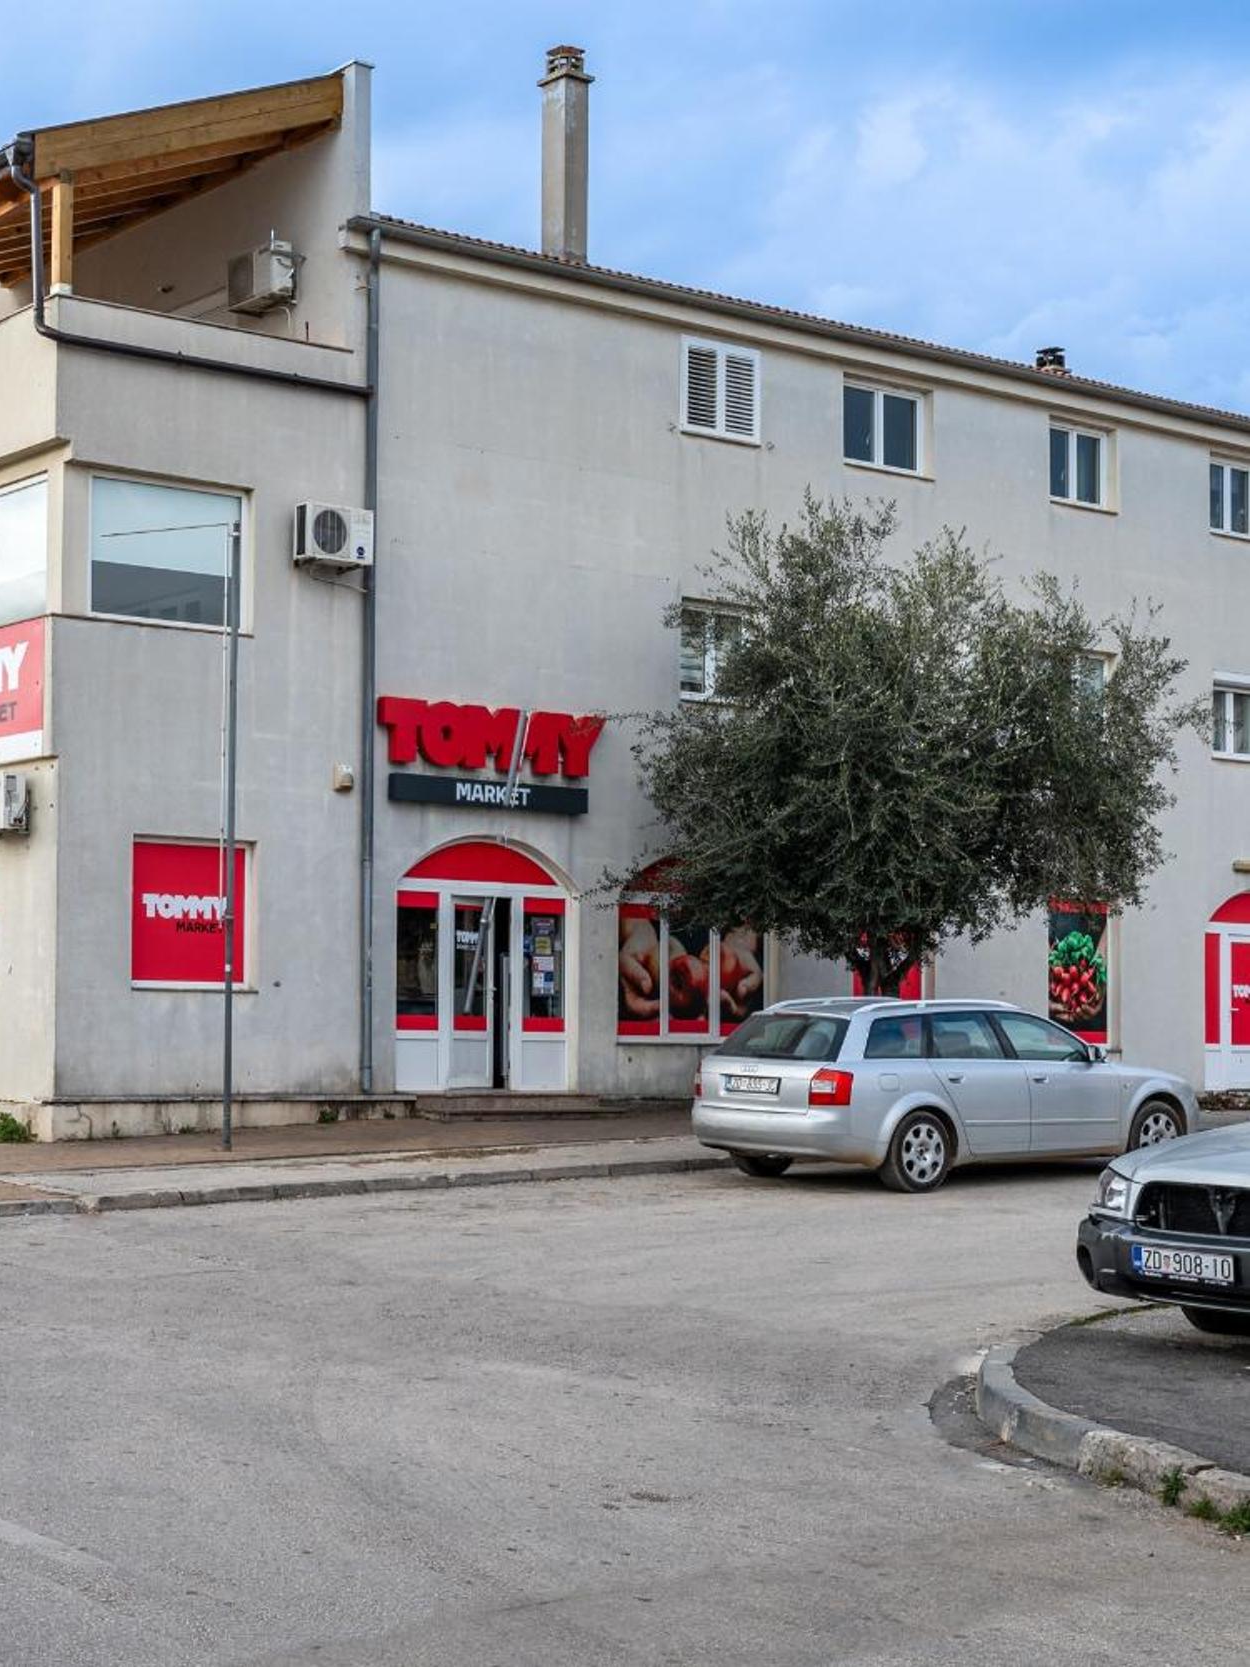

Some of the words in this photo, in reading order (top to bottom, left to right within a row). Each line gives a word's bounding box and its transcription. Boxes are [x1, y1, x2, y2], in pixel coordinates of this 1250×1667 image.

[377, 696, 607, 779] TOMMY
[456, 782, 531, 806] MARKET
[142, 893, 228, 920] TOMMY
[1144, 1249, 1162, 1270] ZD
